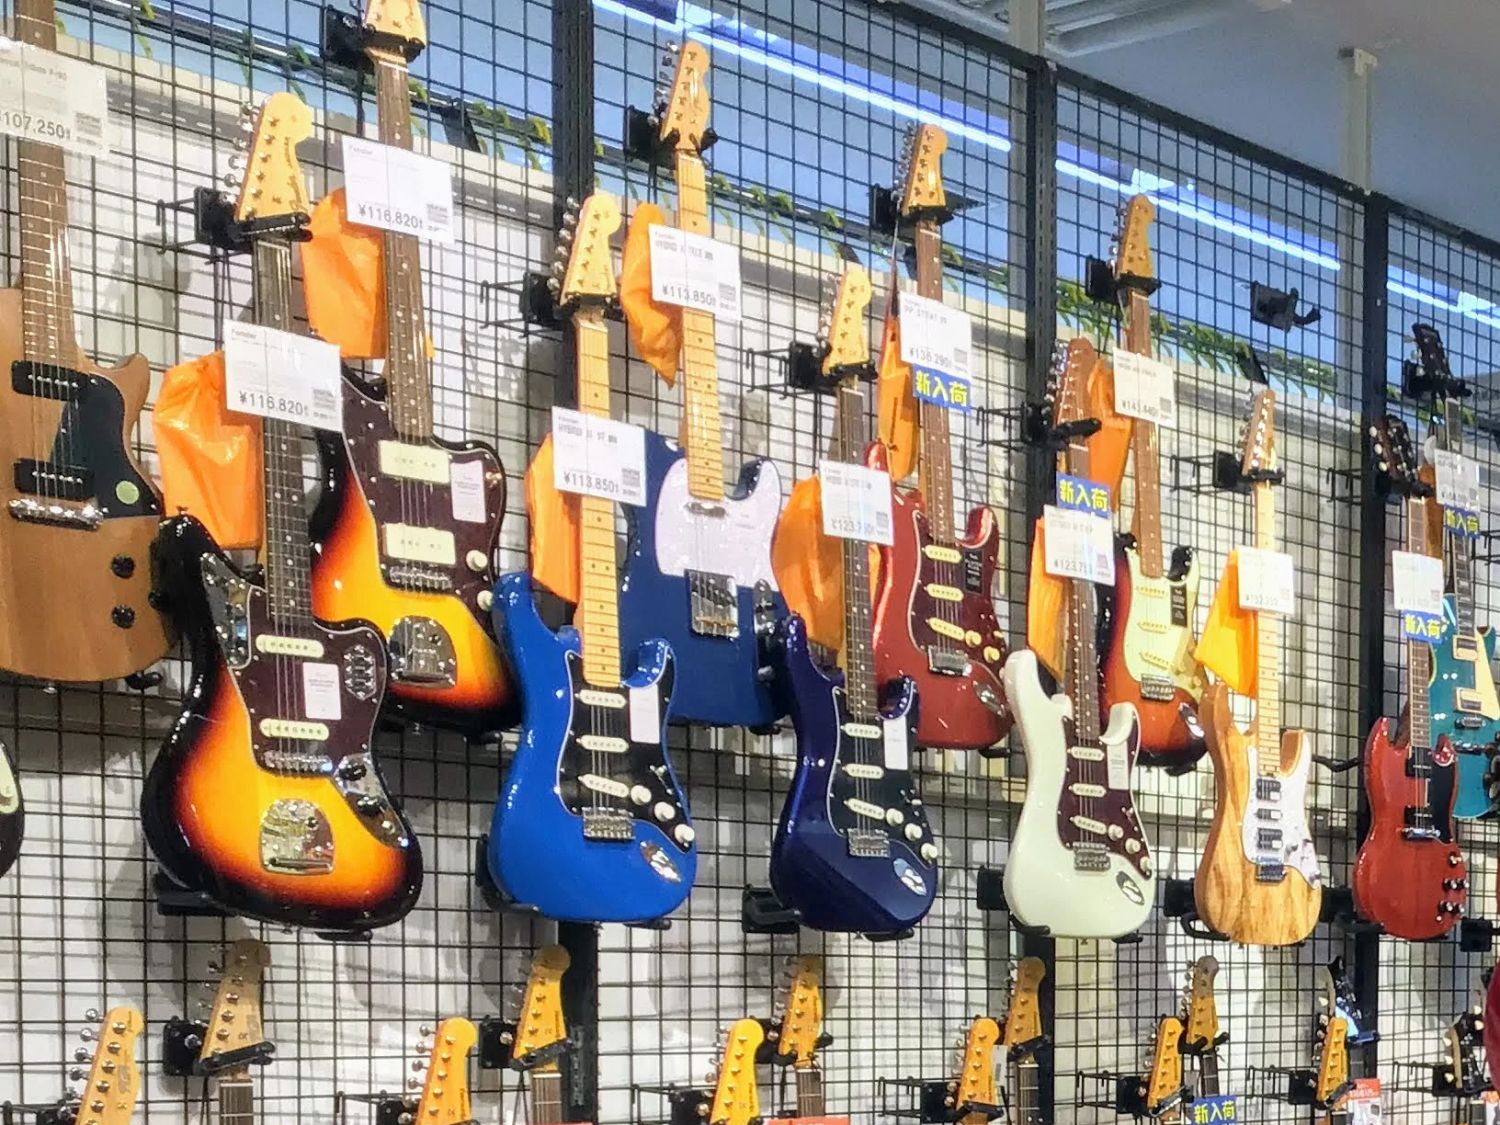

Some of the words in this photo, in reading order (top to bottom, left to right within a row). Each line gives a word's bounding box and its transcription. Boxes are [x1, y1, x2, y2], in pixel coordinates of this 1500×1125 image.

[0, 110, 64, 140] 107,250
[916, 369, 968, 407] 新入荷
[1059, 479, 1109, 511] 新入荷
[1194, 1100, 1236, 1124] 新入荷
